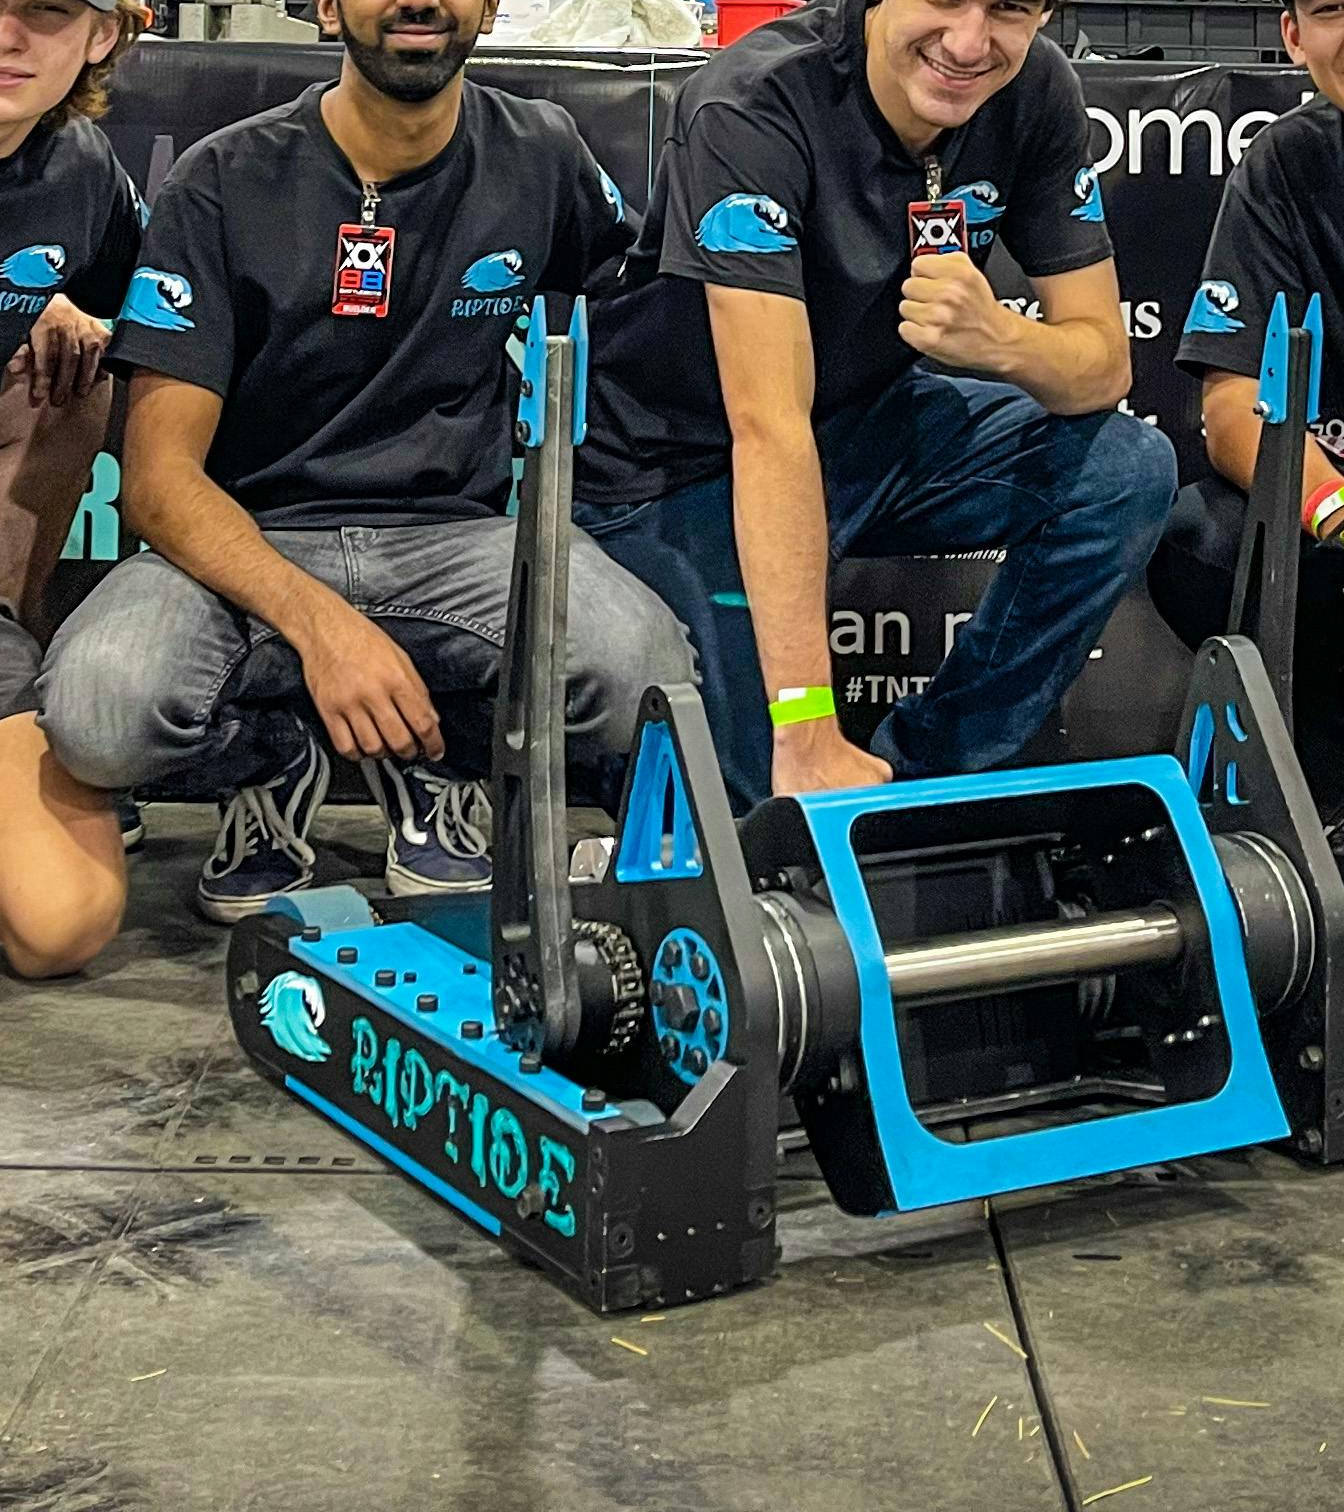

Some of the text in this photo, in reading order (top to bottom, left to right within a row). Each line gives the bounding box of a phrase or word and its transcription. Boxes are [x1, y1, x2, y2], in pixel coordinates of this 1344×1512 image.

[1084, 91, 1313, 177] ome
[452, 295, 523, 318] RIPTIDE
[845, 675, 937, 704] #TNT
[349, 1015, 577, 1239] RIPTIDE
